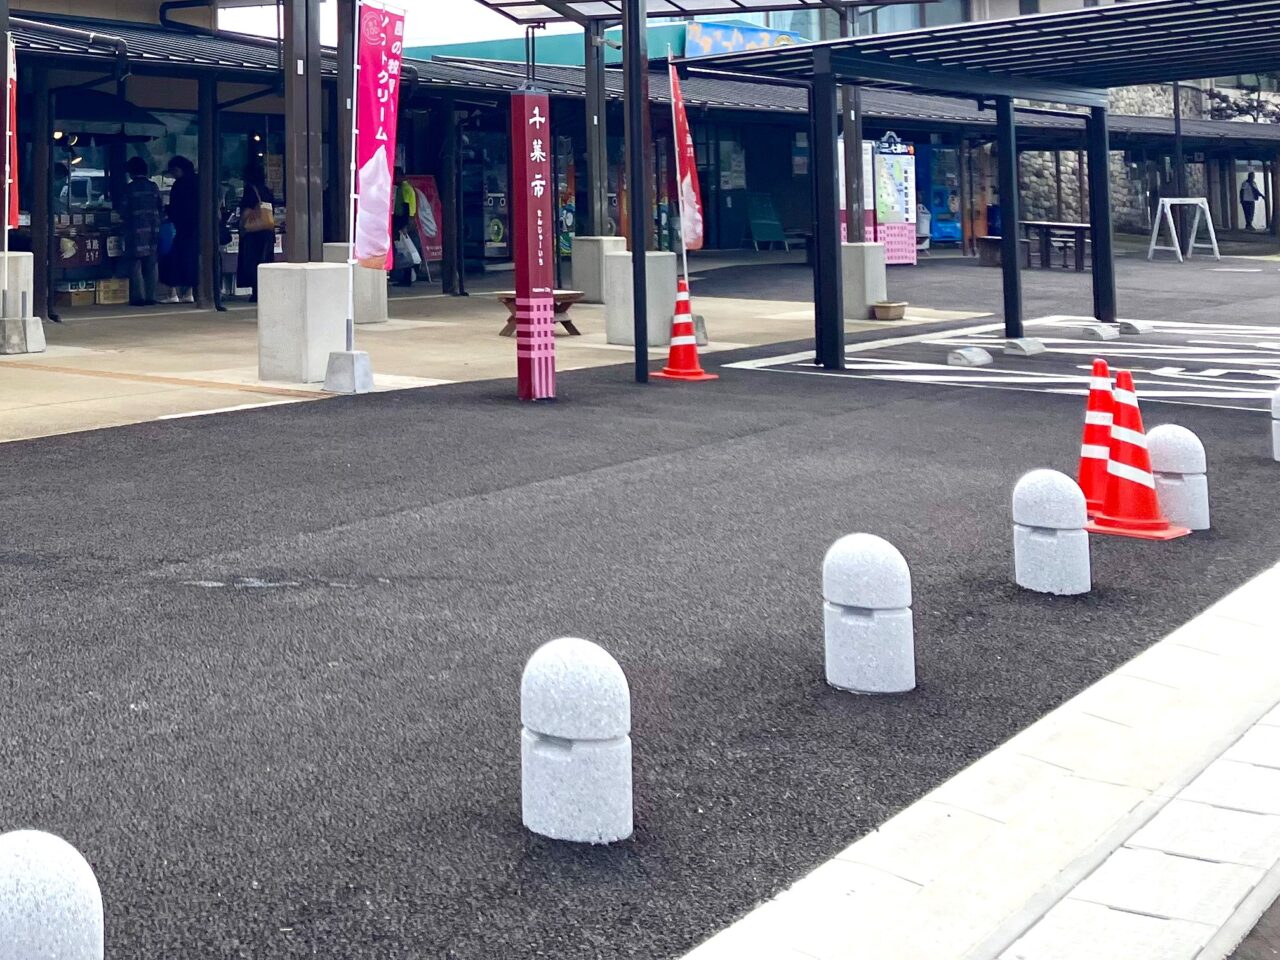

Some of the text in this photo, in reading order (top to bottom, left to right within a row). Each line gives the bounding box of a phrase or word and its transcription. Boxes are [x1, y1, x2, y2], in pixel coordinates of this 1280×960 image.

[375, 13, 389, 141] ソフトクリーム
